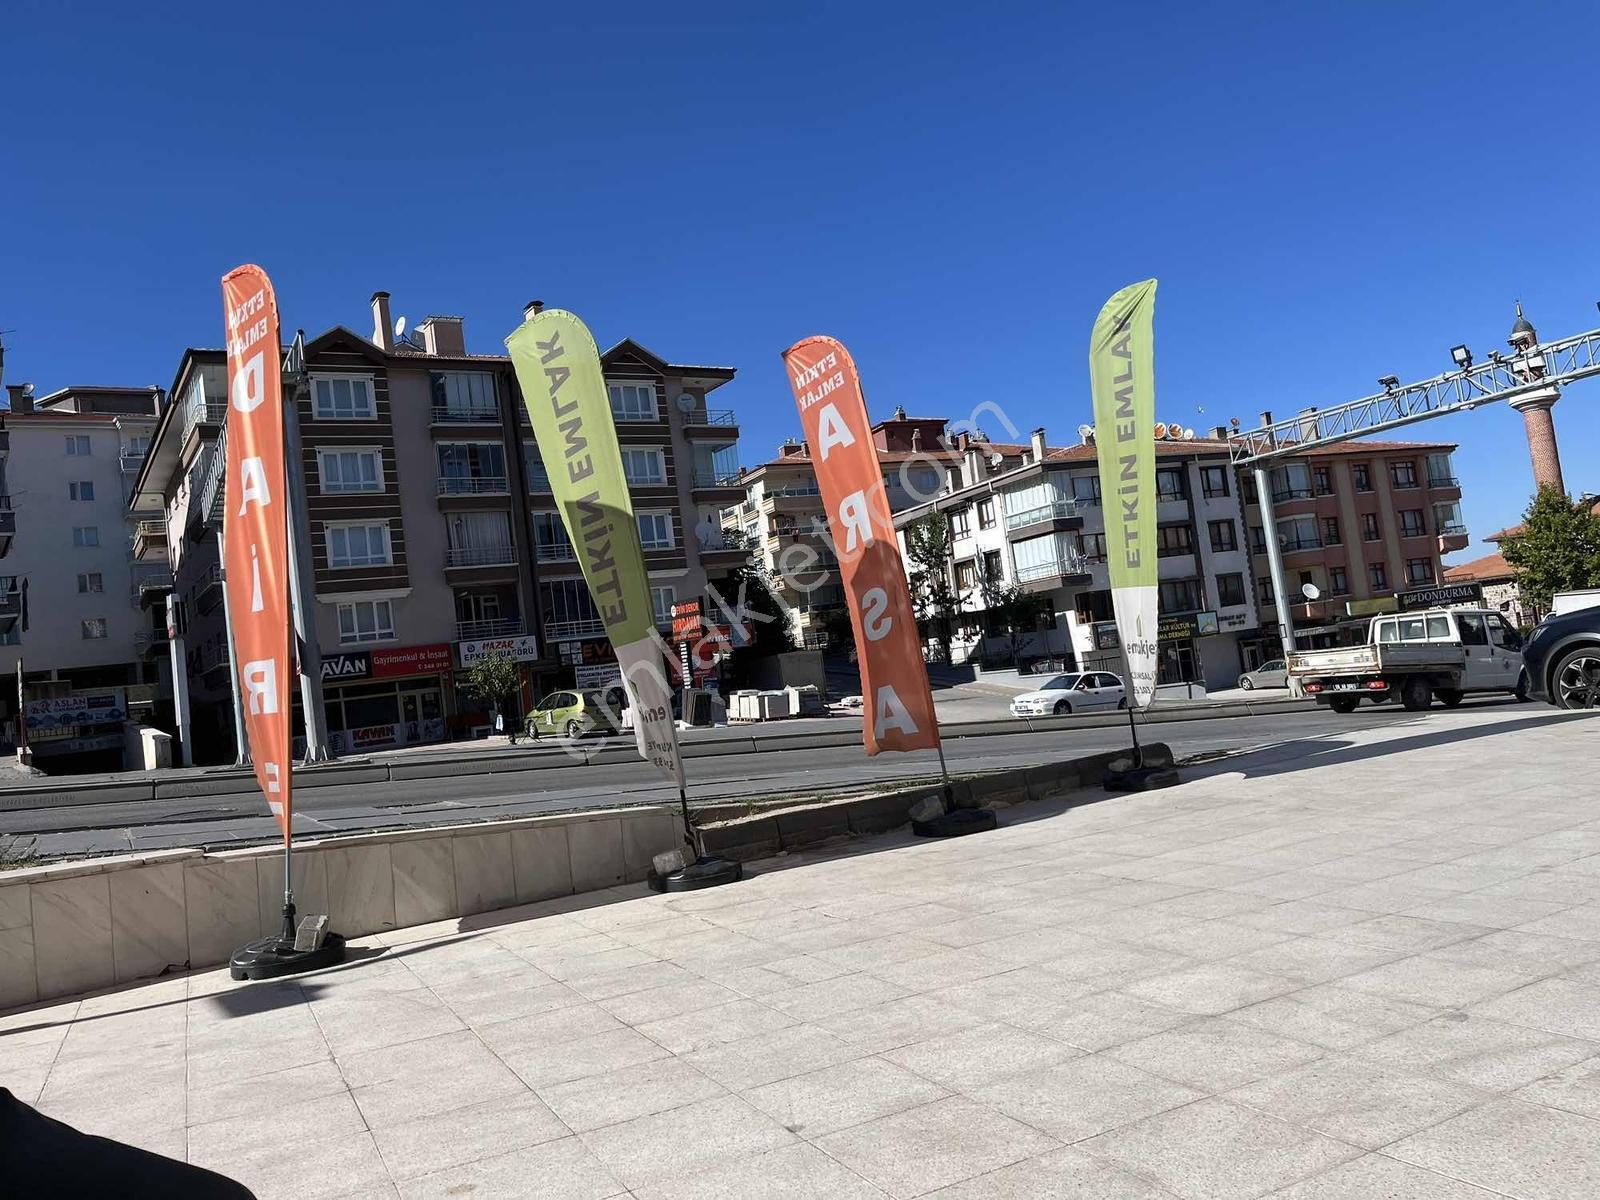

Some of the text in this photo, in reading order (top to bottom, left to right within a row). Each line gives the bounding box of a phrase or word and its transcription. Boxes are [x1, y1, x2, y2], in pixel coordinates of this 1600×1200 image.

[1117, 453, 1141, 569] ETKİN
[1417, 586, 1474, 602] DONDURMA
[373, 653, 417, 666] Gayrimenkul
[419, 652, 426, 660] &
[496, 645, 534, 658] UAÖRÜ
[321, 656, 366, 677] AVAN
[54, 697, 86, 708] ASLAN
